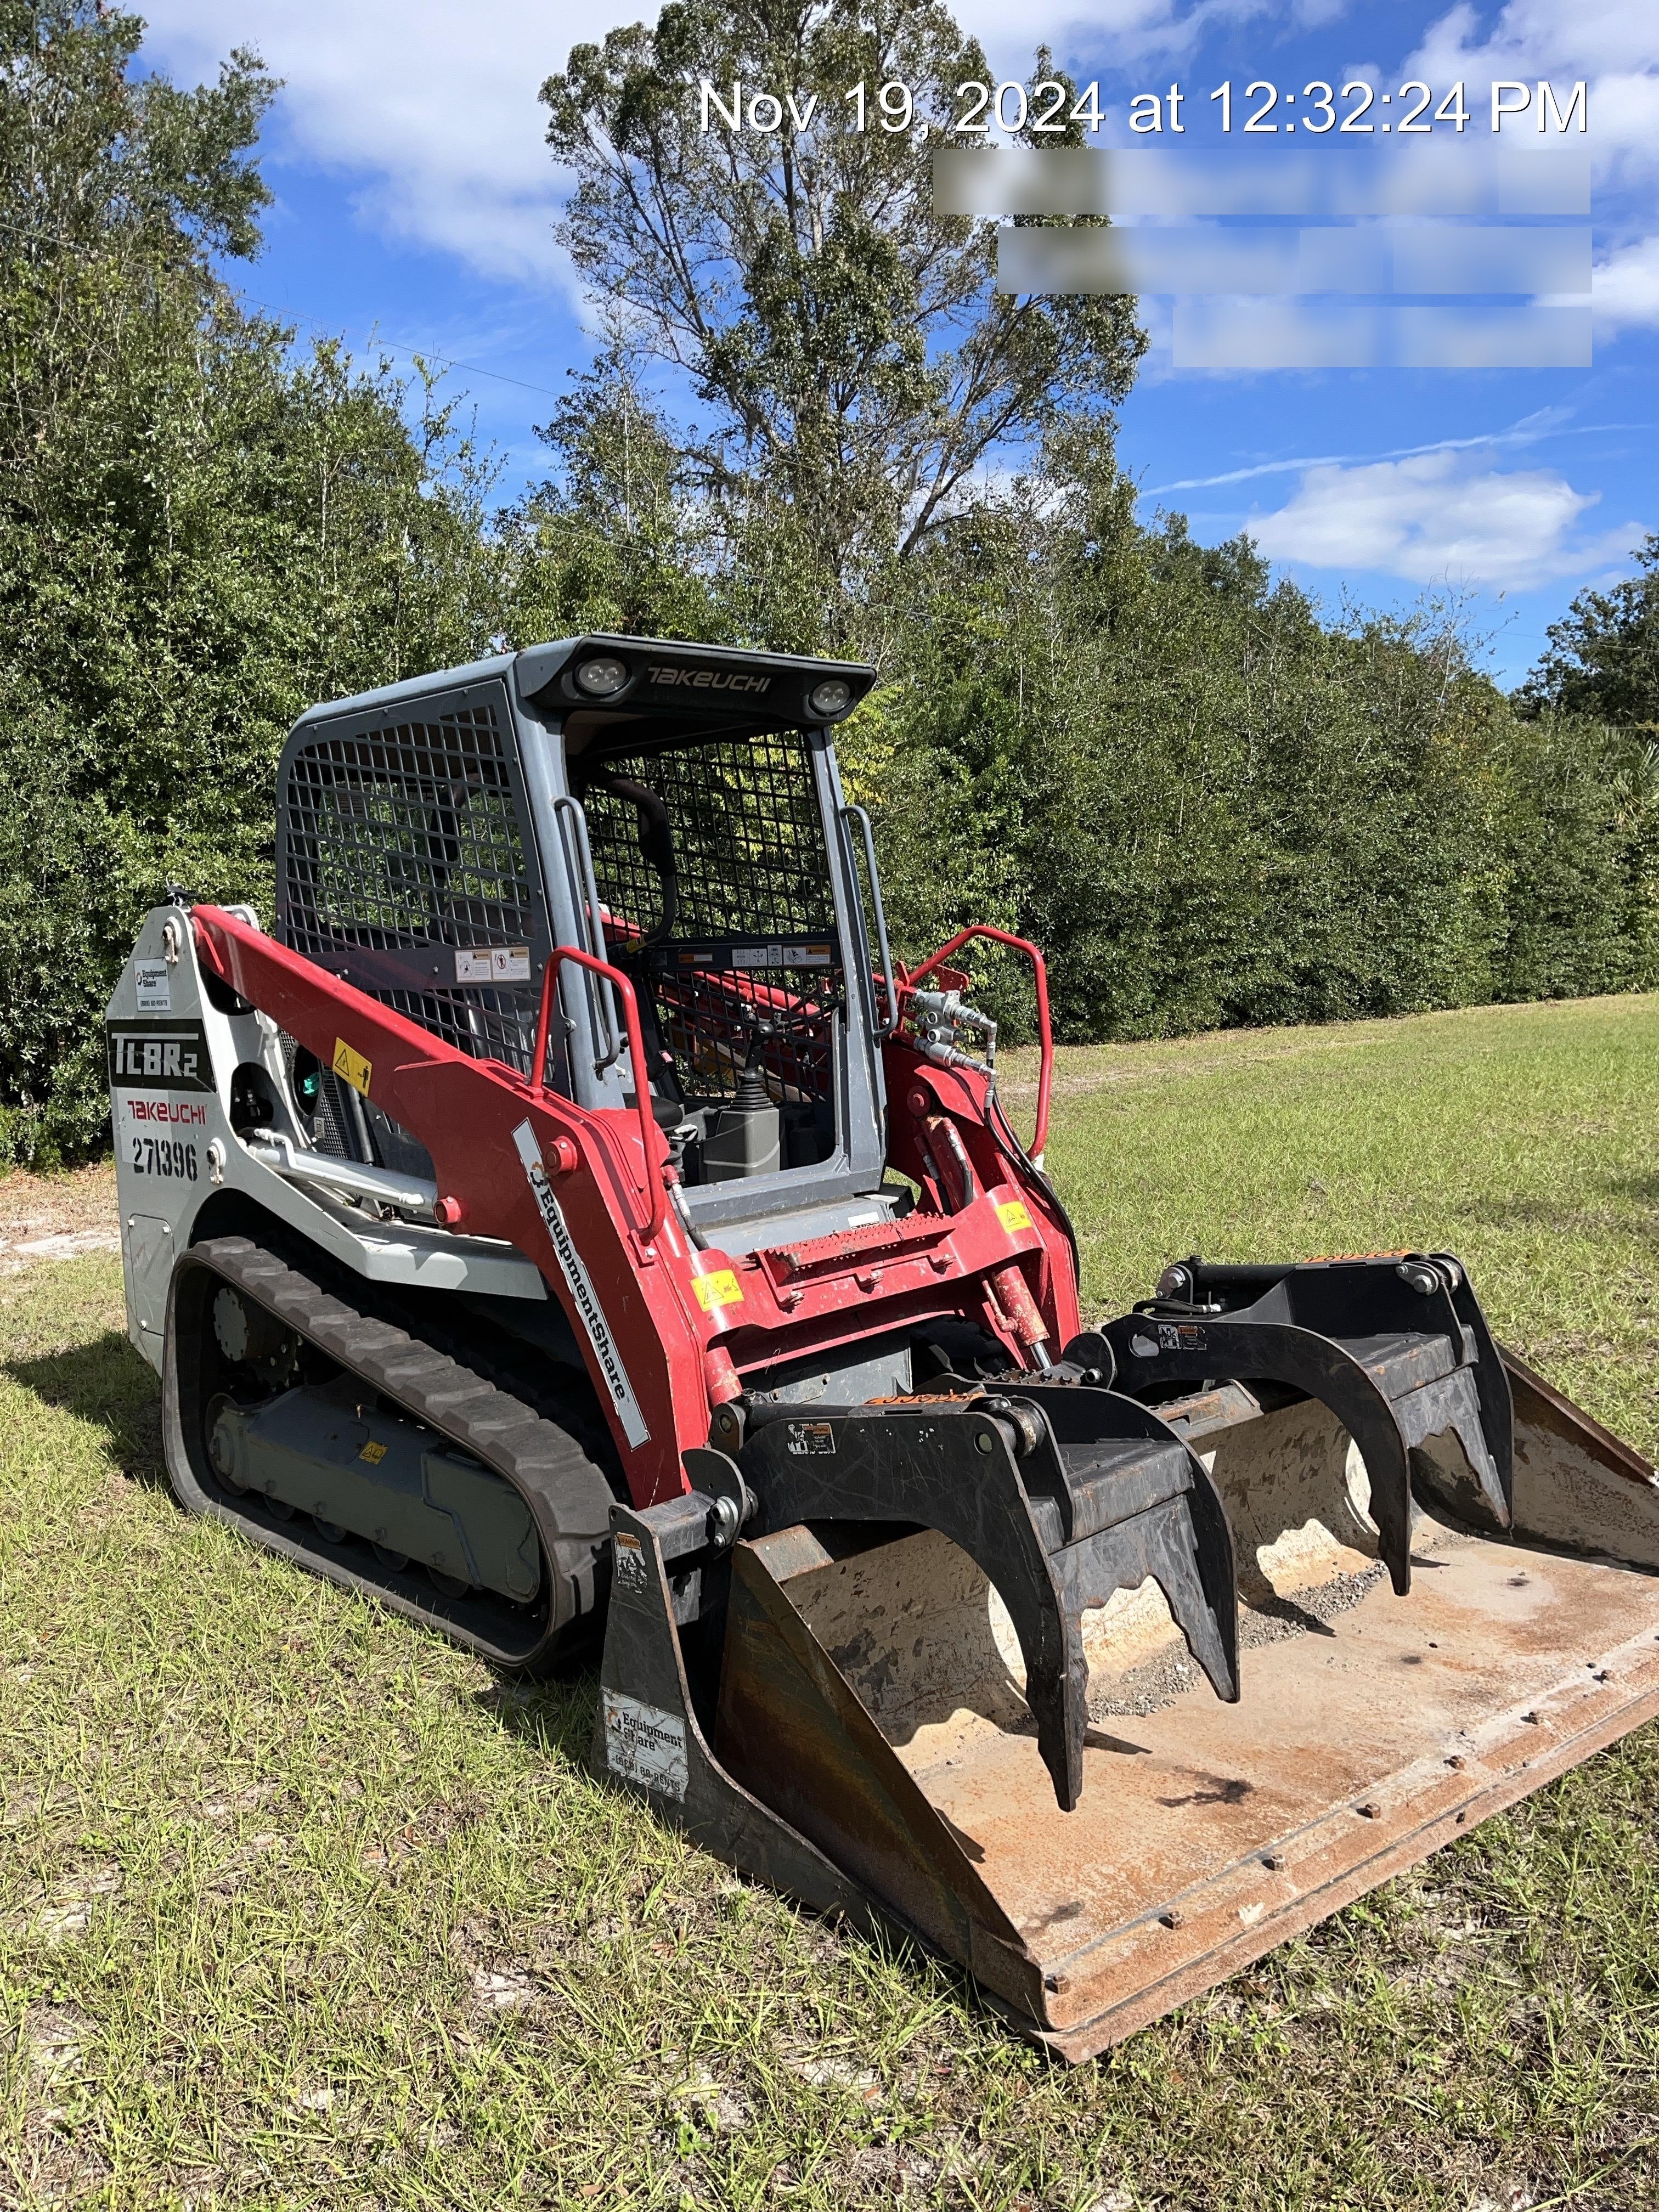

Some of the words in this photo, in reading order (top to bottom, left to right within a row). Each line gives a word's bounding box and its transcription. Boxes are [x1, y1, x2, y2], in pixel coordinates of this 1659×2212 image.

[132, 1136, 198, 1181] 271396
[540, 1191, 625, 1401] EquipmentShare
[622, 1711, 682, 1748] Equipment
